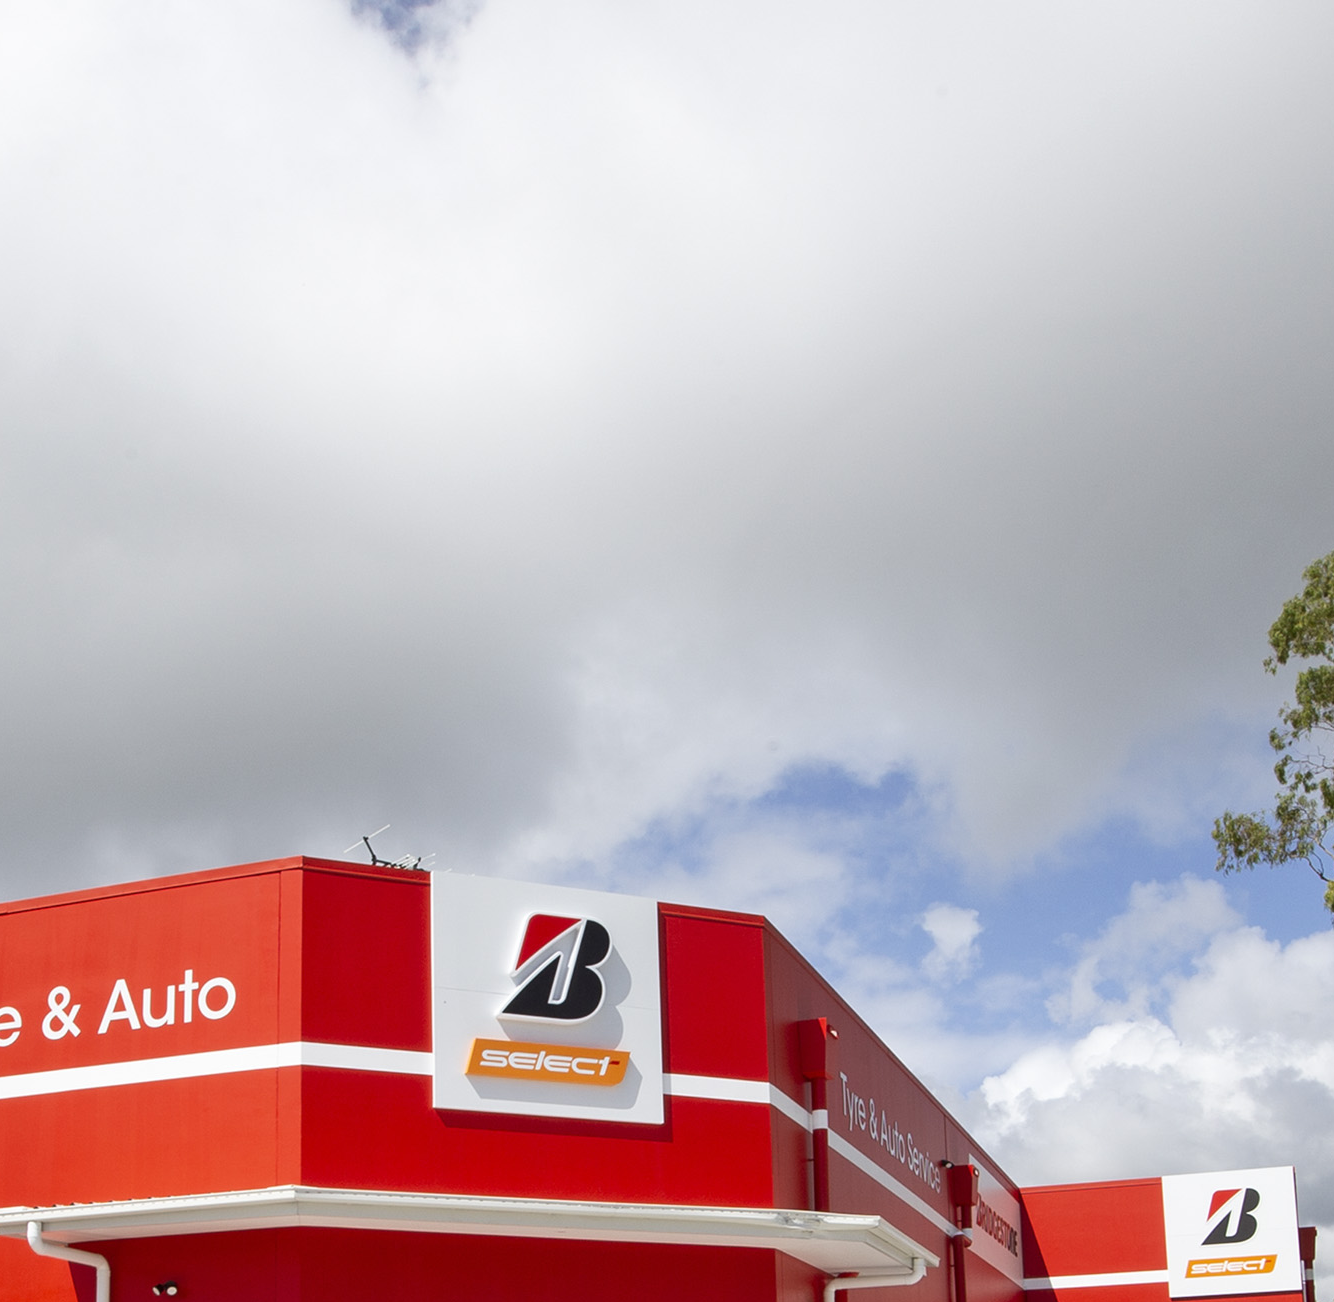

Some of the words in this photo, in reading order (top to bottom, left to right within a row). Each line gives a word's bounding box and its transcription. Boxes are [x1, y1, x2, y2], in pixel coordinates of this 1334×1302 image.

[41, 985, 81, 1040] &
[97, 969, 236, 1035] Auto
[840, 1071, 866, 1131] Tyre
[869, 1098, 878, 1141] &
[881, 1110, 905, 1164] Auto
[907, 1133, 941, 1194] Service
